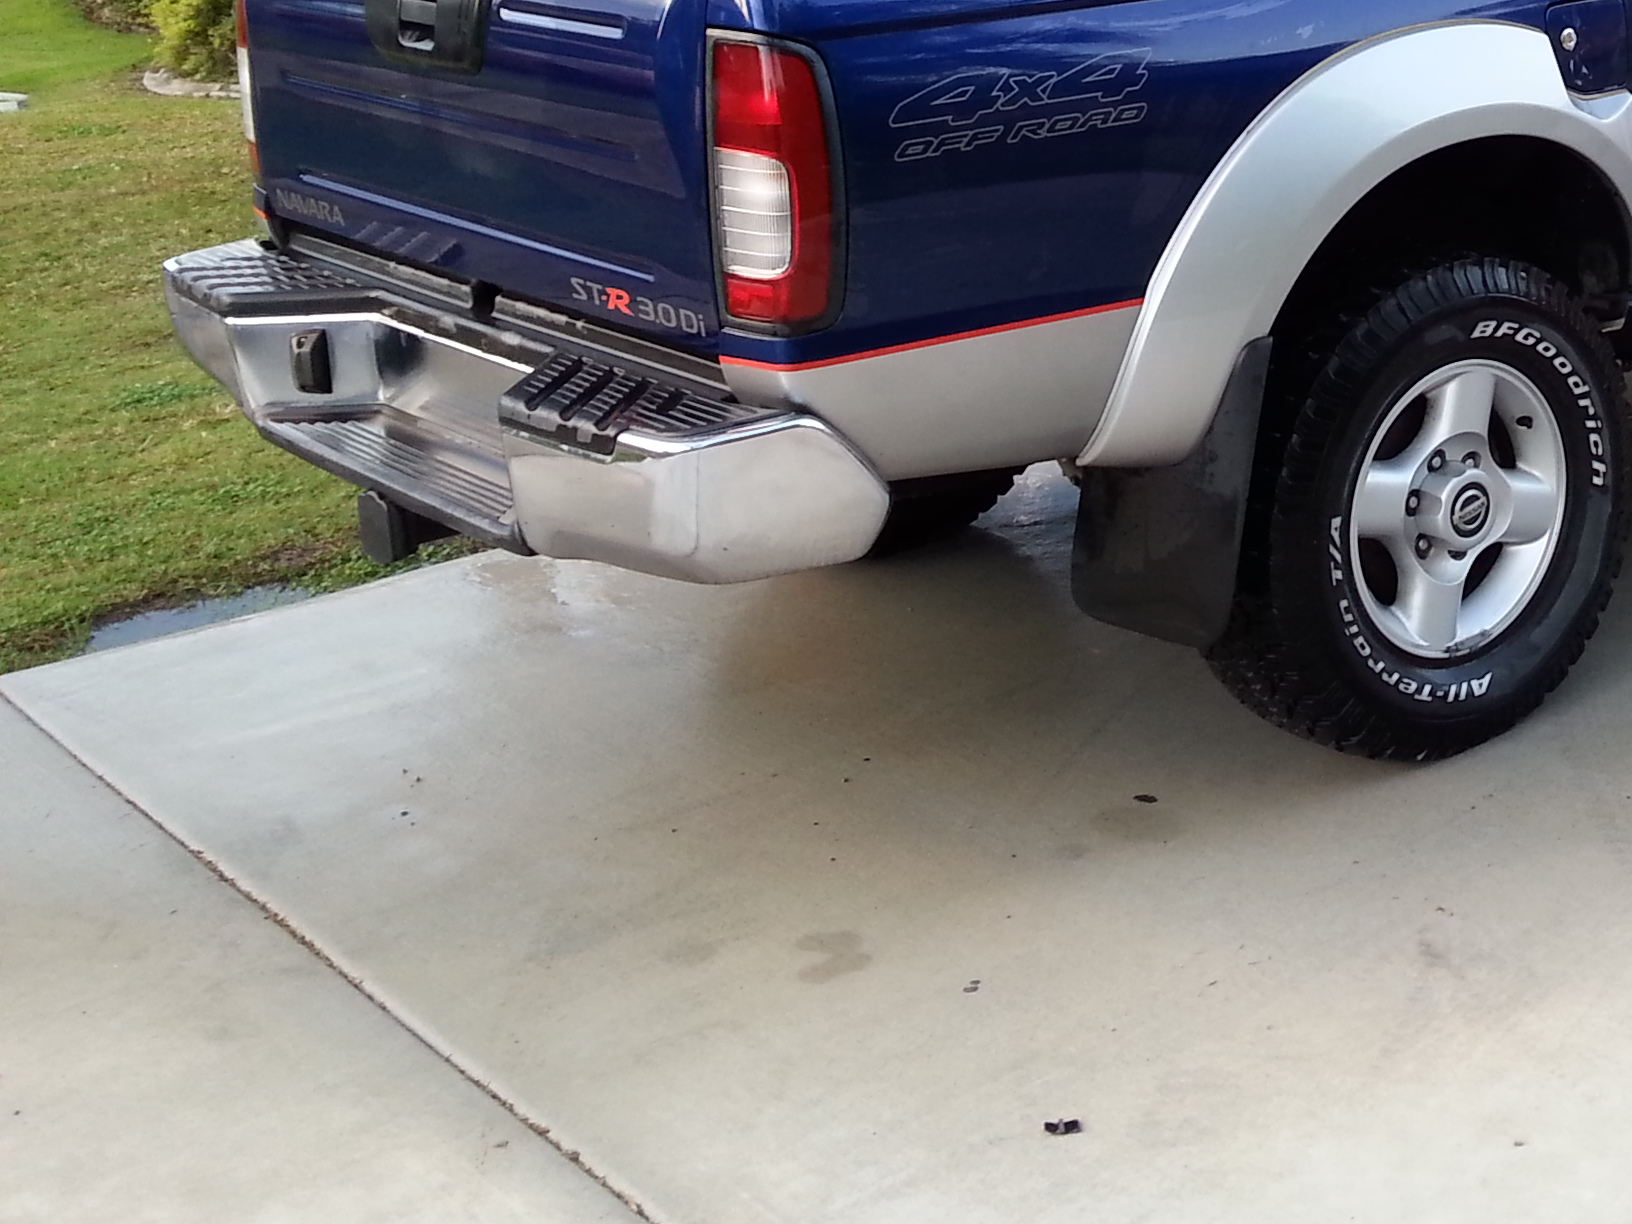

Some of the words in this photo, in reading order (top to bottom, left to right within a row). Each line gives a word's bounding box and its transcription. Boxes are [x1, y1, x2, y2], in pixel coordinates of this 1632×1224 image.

[889, 47, 1151, 126] 4x4
[894, 125, 1004, 162] OFF
[1007, 103, 1147, 143] ROAD
[276, 188, 345, 226] NAVARA
[1470, 320, 1607, 486] BFGoodrich
[1329, 516, 1343, 586] T/A
[1339, 599, 1493, 703] All-Terrain
